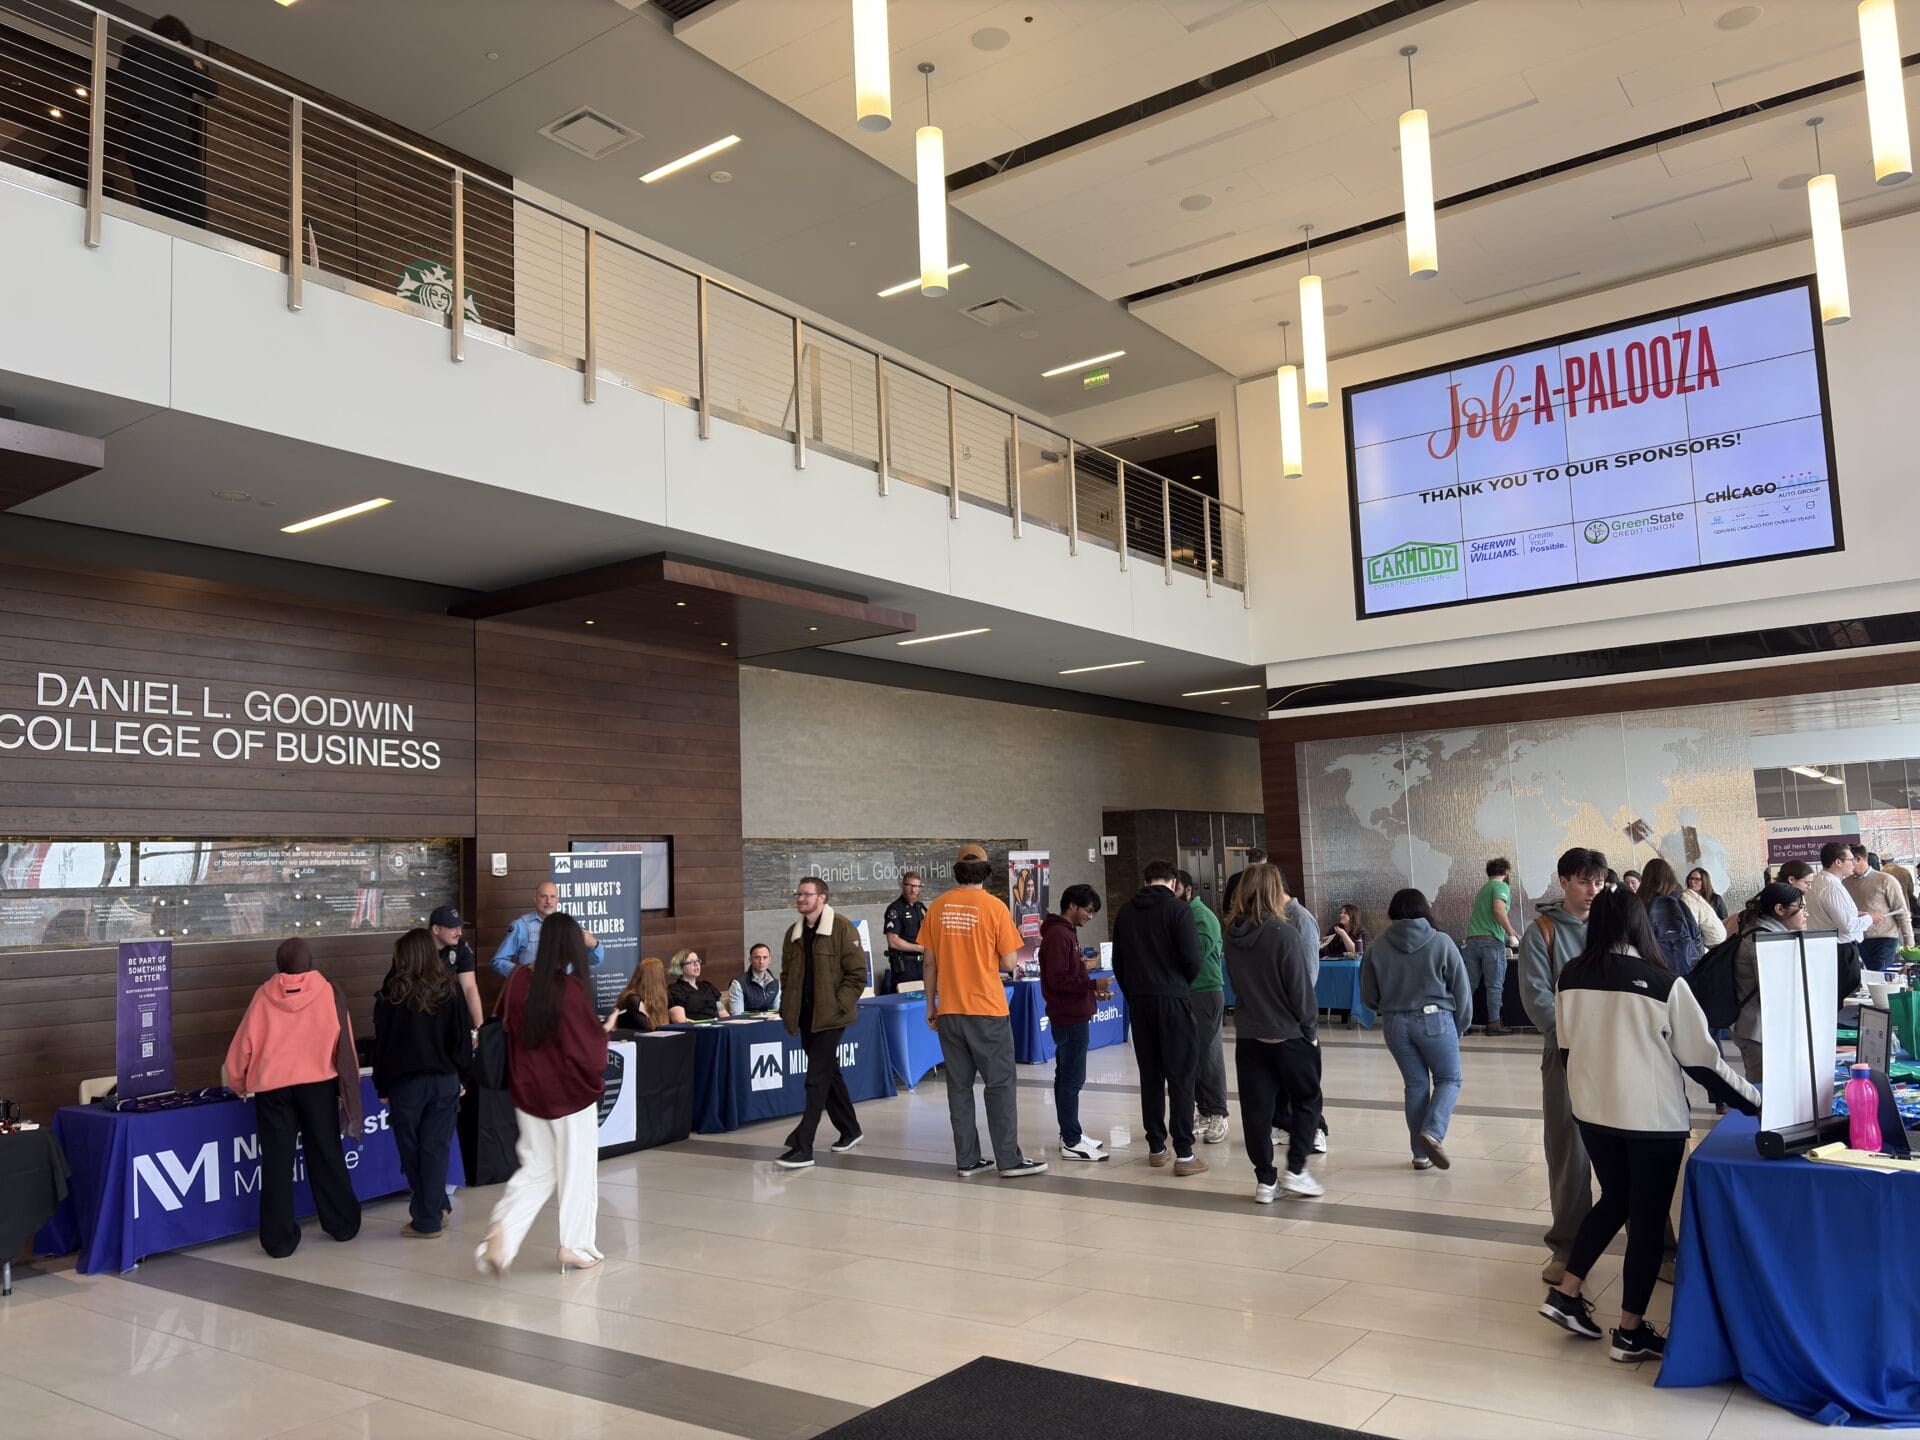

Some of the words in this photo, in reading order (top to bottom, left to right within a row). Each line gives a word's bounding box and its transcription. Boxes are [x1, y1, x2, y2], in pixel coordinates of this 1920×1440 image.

[1419, 482, 1484, 504] THANK
[1488, 473, 1528, 491] YOU
[1533, 468, 1560, 483] TO
[1565, 459, 1609, 477] OUR
[1614, 432, 1742, 468] SPONSORS!
[1797, 486, 1821, 495] GROUP
[1611, 511, 1684, 531] GreenState
[1528, 530, 1554, 541] Create
[1612, 527, 1644, 538] CREDIT
[1647, 523, 1675, 533] UNION
[1470, 537, 1517, 553] SHERWIN
[1529, 538, 1548, 547] Your
[1530, 542, 1568, 553] Possible.
[1371, 546, 1453, 580] CARMODY
[37, 672, 193, 716] DANIEL
[203, 686, 231, 719] L.
[244, 690, 414, 732] GOODWIN
[0, 713, 201, 758] COLLEGE
[212, 727, 264, 760] OF
[276, 732, 441, 770] BUSINESS
[323, 850, 336, 859] right
[310, 859, 341, 867] influencing
[810, 863, 853, 883] Daniel
[857, 862, 869, 881] L.
[872, 860, 927, 881] Goodwin
[930, 860, 952, 879] Hall
[555, 883, 572, 898] THE
[574, 881, 622, 898] MIDWEST'S
[556, 901, 585, 917] RETAIL
[587, 900, 608, 916] REAL
[589, 918, 625, 934] LEADERS
[139, 956, 156, 964] PART
[158, 955, 166, 963] OF
[128, 965, 167, 974] SOMETHING
[135, 974, 160, 982] BETTER
[1092, 1005, 1119, 1023] Health
